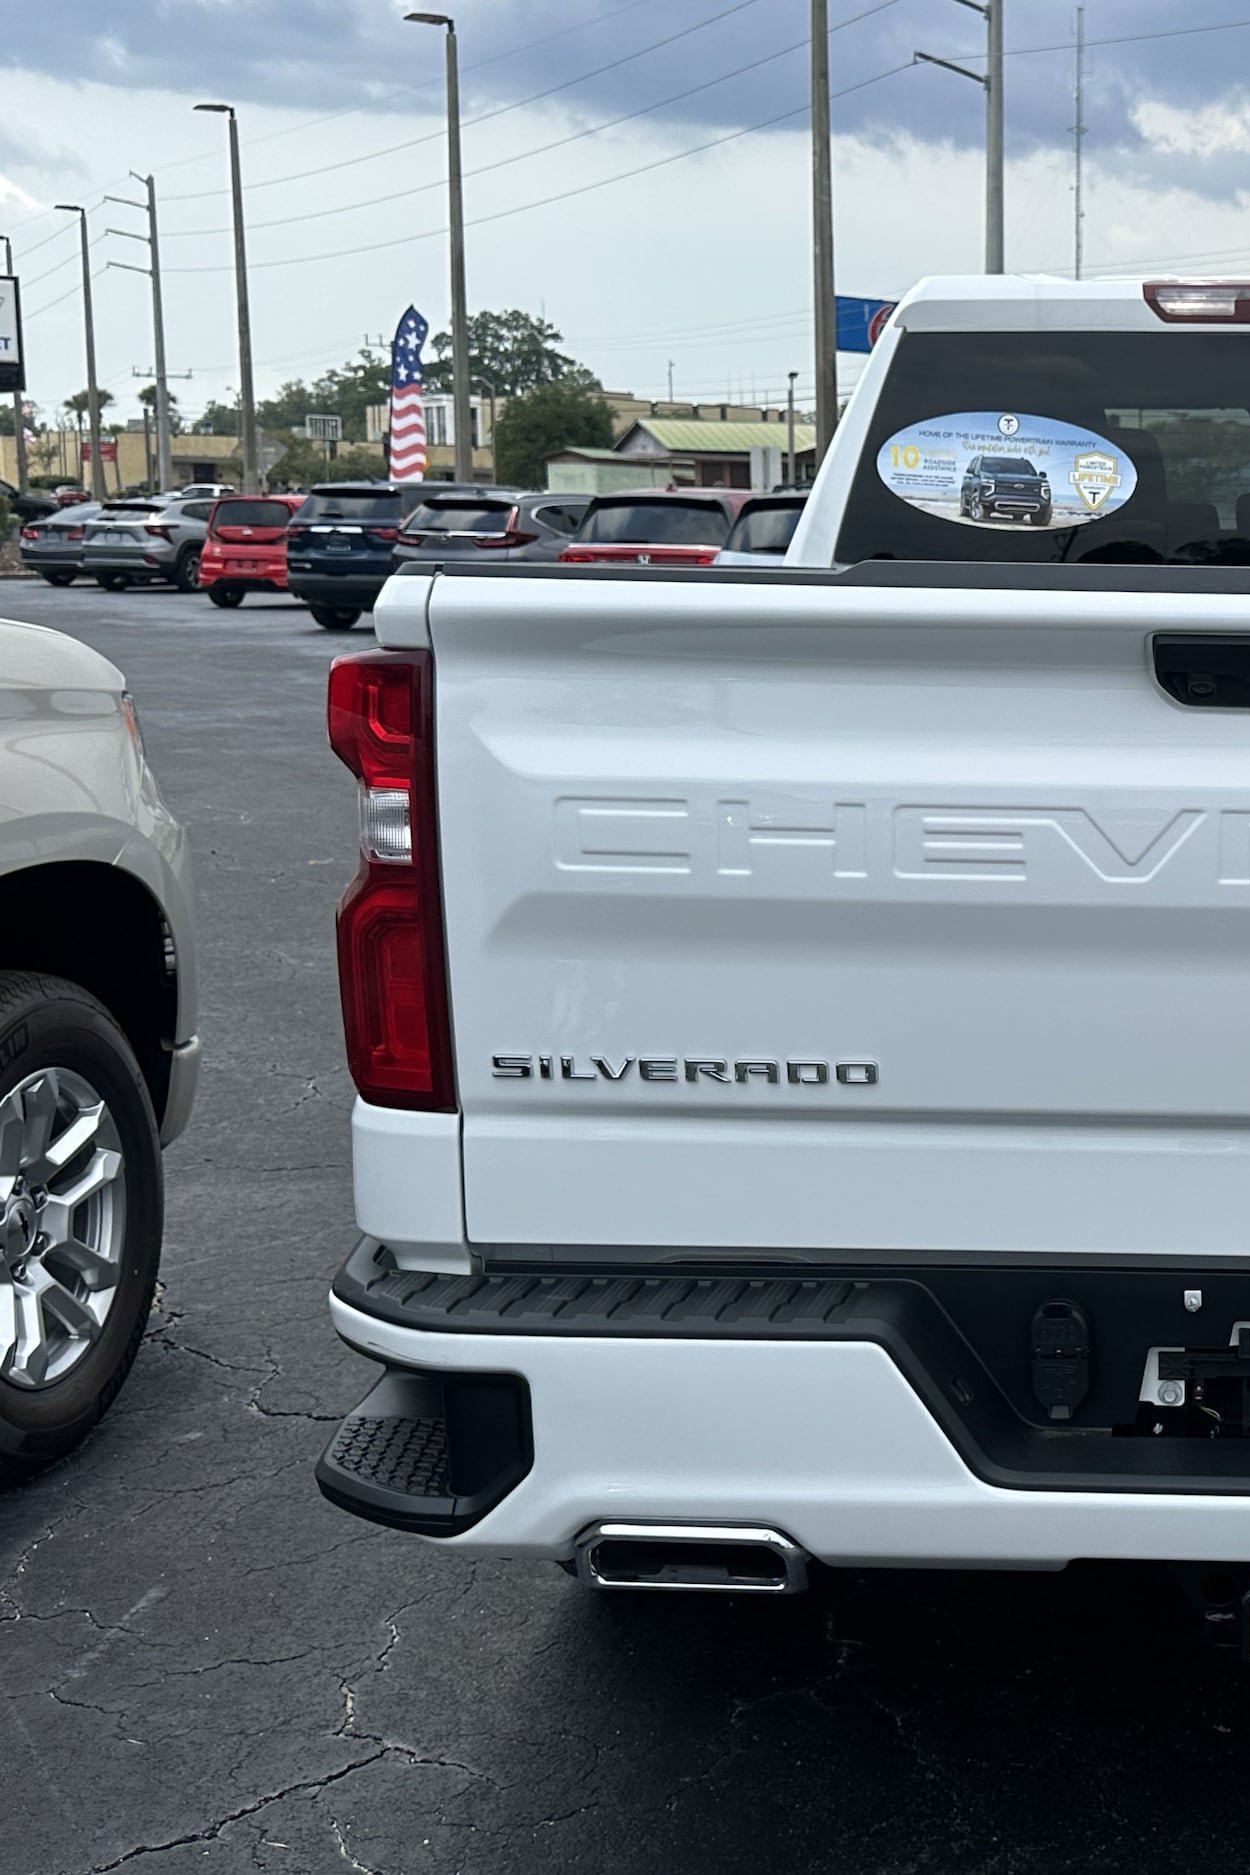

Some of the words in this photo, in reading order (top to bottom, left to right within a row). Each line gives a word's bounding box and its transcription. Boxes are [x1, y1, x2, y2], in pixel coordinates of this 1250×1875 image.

[918, 430, 942, 439] HOME
[943, 431, 953, 439] OF
[955, 432, 969, 440] THE
[970, 434, 1003, 442] LIFETIME
[890, 443, 920, 469] 10
[1073, 473, 1119, 485] LIFETIME
[491, 1054, 880, 1084] SILVERADO
